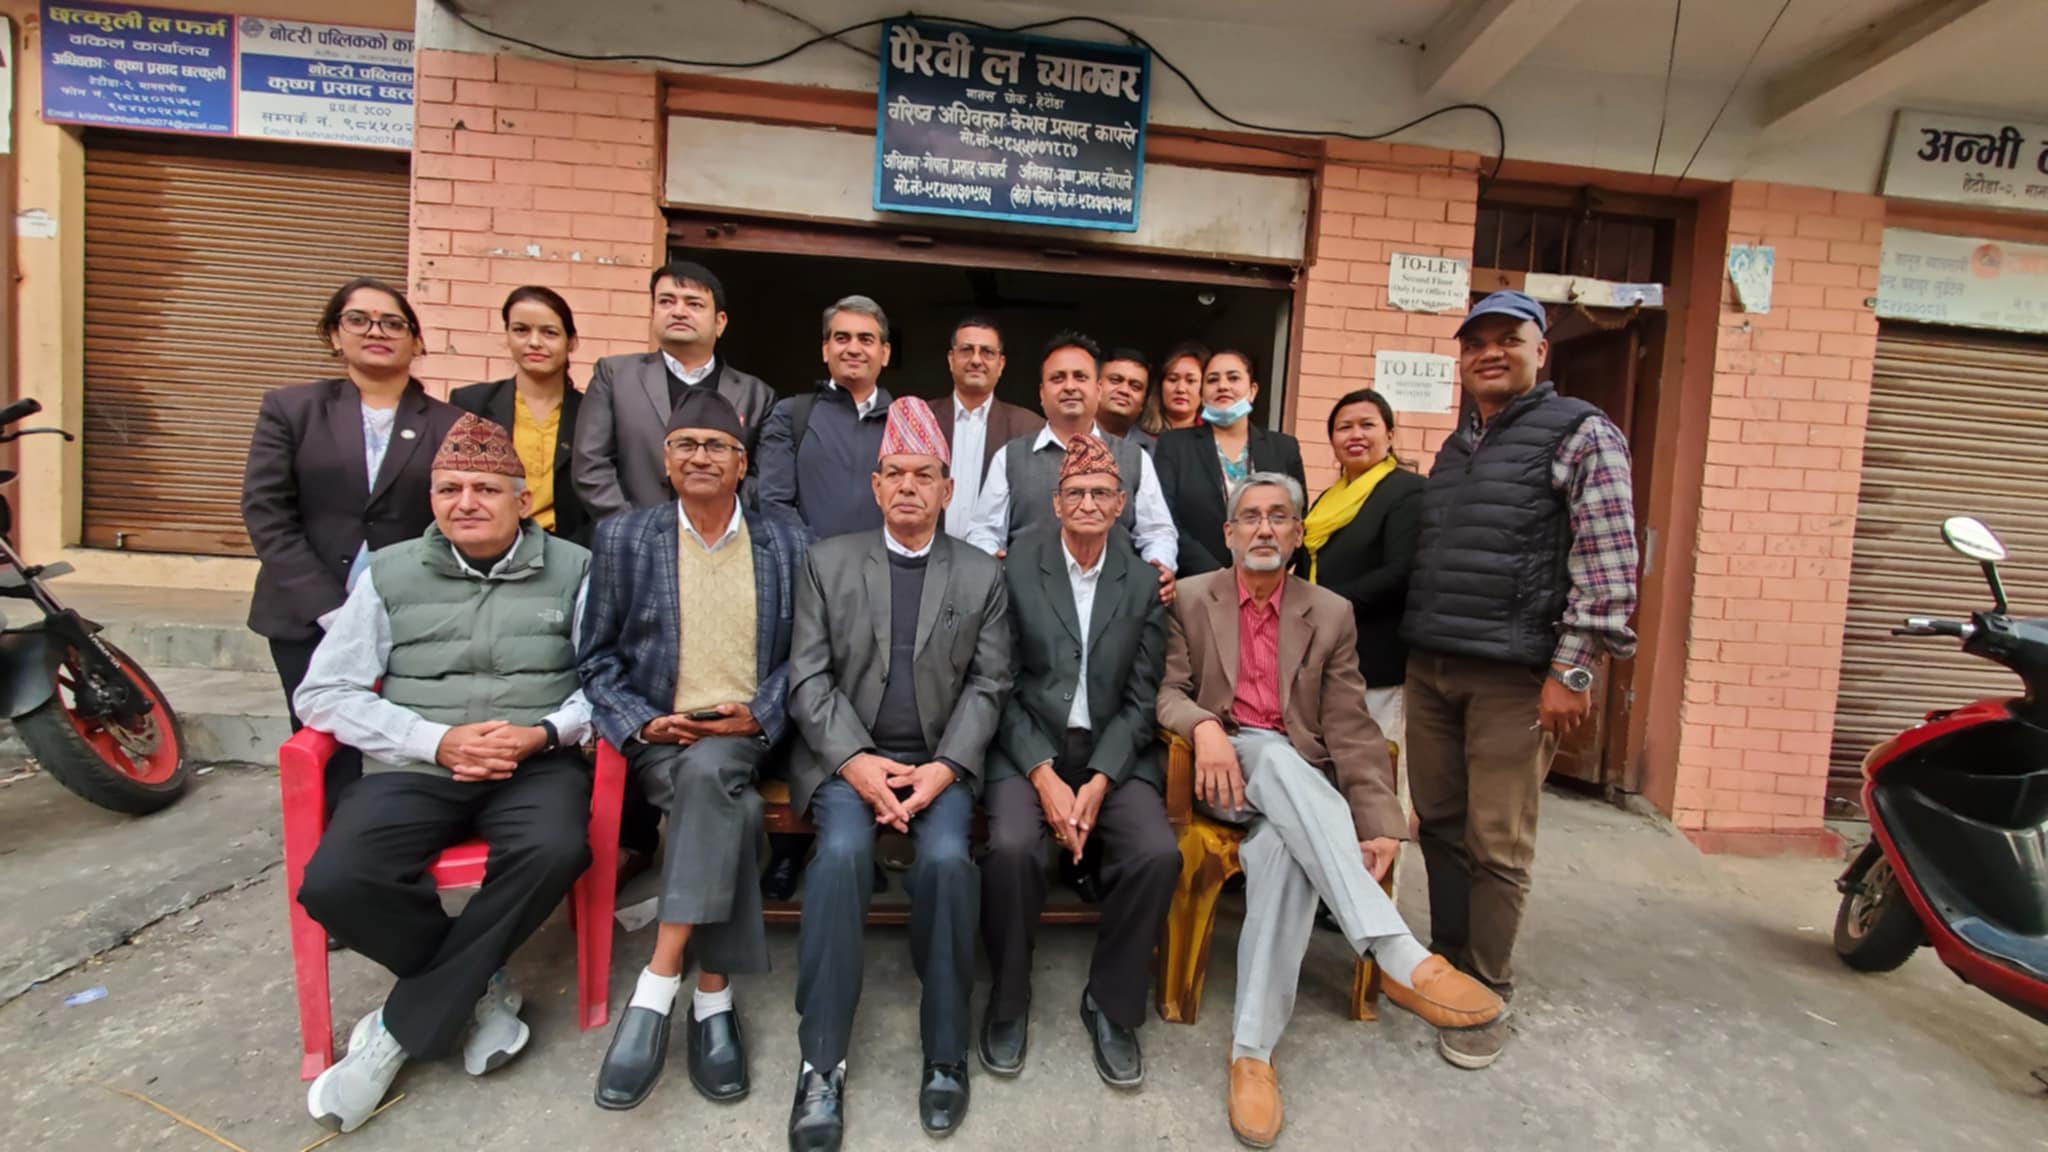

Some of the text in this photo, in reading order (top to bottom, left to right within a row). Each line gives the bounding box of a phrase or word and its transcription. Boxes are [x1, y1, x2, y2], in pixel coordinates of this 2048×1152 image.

[148, 16, 171, 33] ल
[175, 19, 227, 37] फर्म
[69, 34, 210, 57] वकिल कार्यालय
[270, 24, 415, 53] नोटरी पब्लिकको का
[114, 59, 144, 75] कृष्ण
[148, 63, 178, 78] प्रसाद
[308, 61, 354, 80] नोटरी
[889, 25, 1141, 103] पैरवी ल च्याम्बर
[267, 76, 316, 94] कृष्ण
[322, 81, 373, 98] प्रसाद
[1049, 117, 1091, 144] प्रसाद
[1400, 256, 1458, 275] TO-LET
[1381, 360, 1450, 378] TO LET
